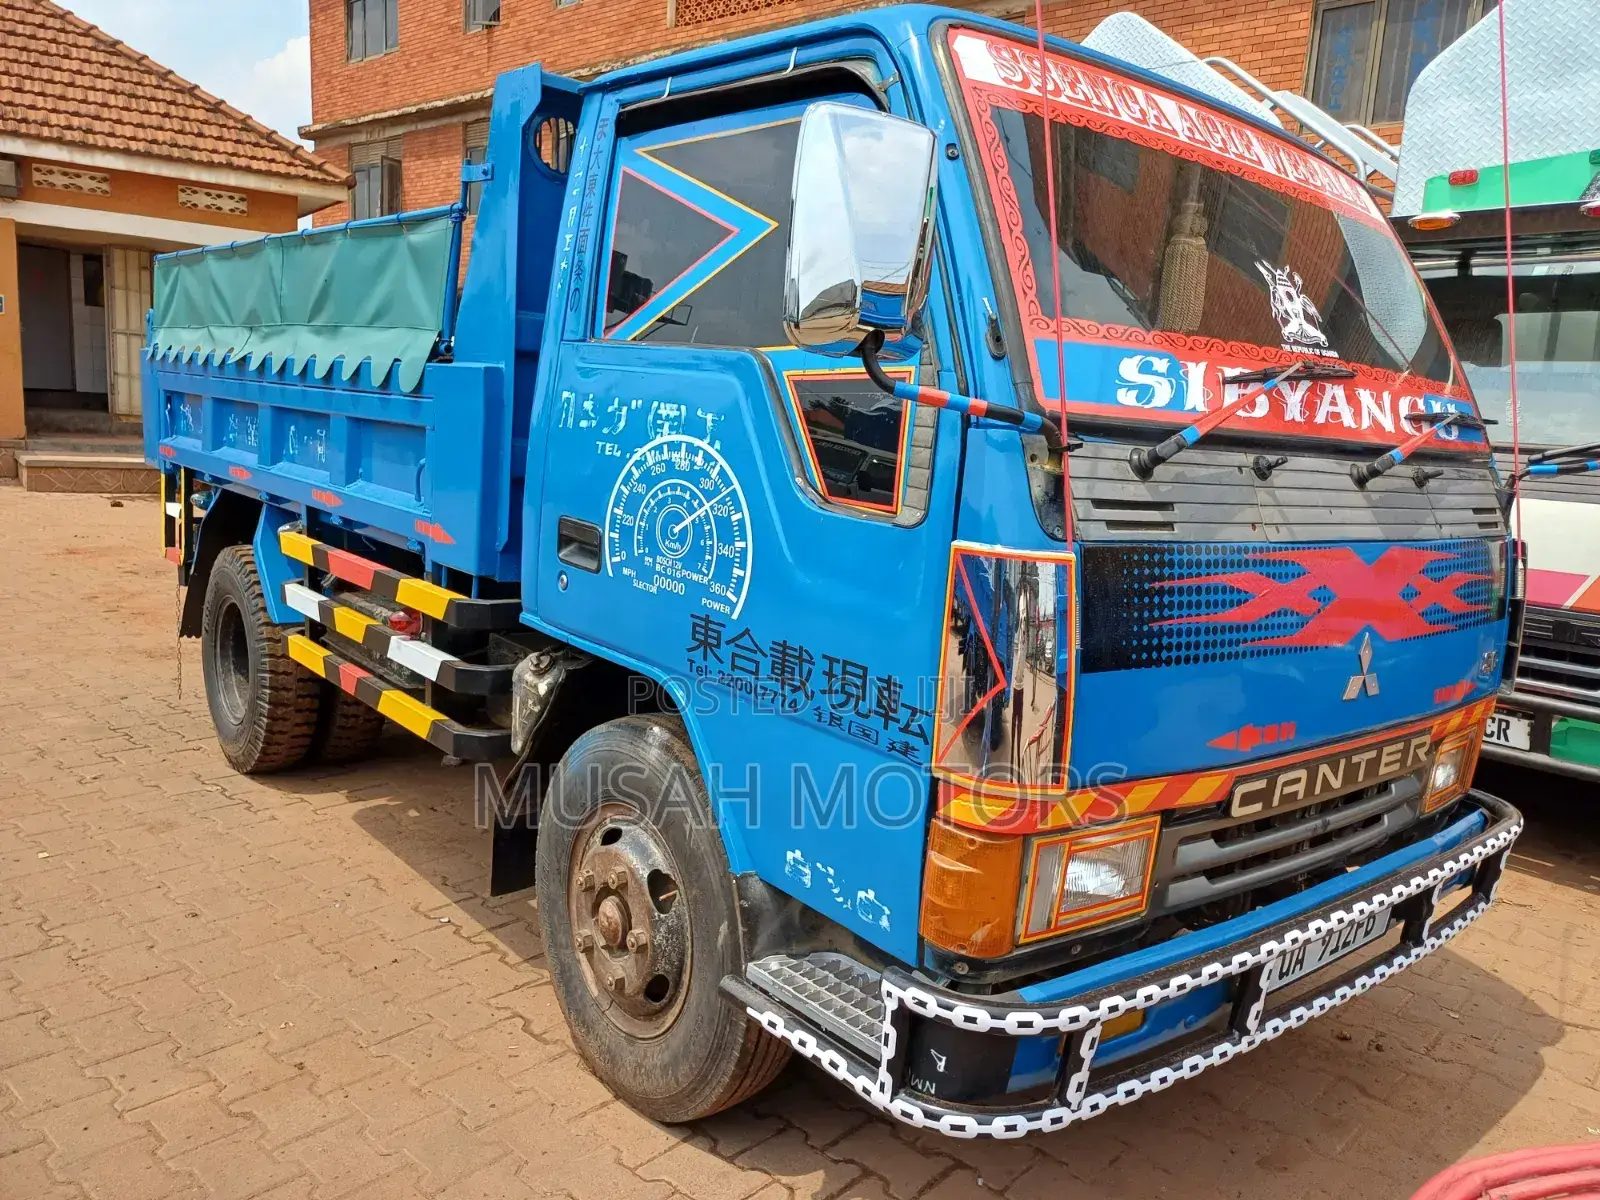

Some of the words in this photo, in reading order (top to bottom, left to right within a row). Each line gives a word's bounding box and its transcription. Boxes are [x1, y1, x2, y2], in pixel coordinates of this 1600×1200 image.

[986, 40, 1180, 137] SSENGA
[651, 463, 666, 476] 260
[632, 482, 647, 495] 240
[699, 478, 715, 490] 300
[712, 503, 729, 517] 320
[622, 513, 635, 527] 220
[717, 542, 735, 558] 340
[622, 567, 637, 578] MPH
[681, 569, 709, 585] POWER
[653, 574, 686, 596] 00000
[709, 581, 727, 596] 360
[701, 597, 731, 615] POWER
[1231, 734, 1431, 818] CANTER
